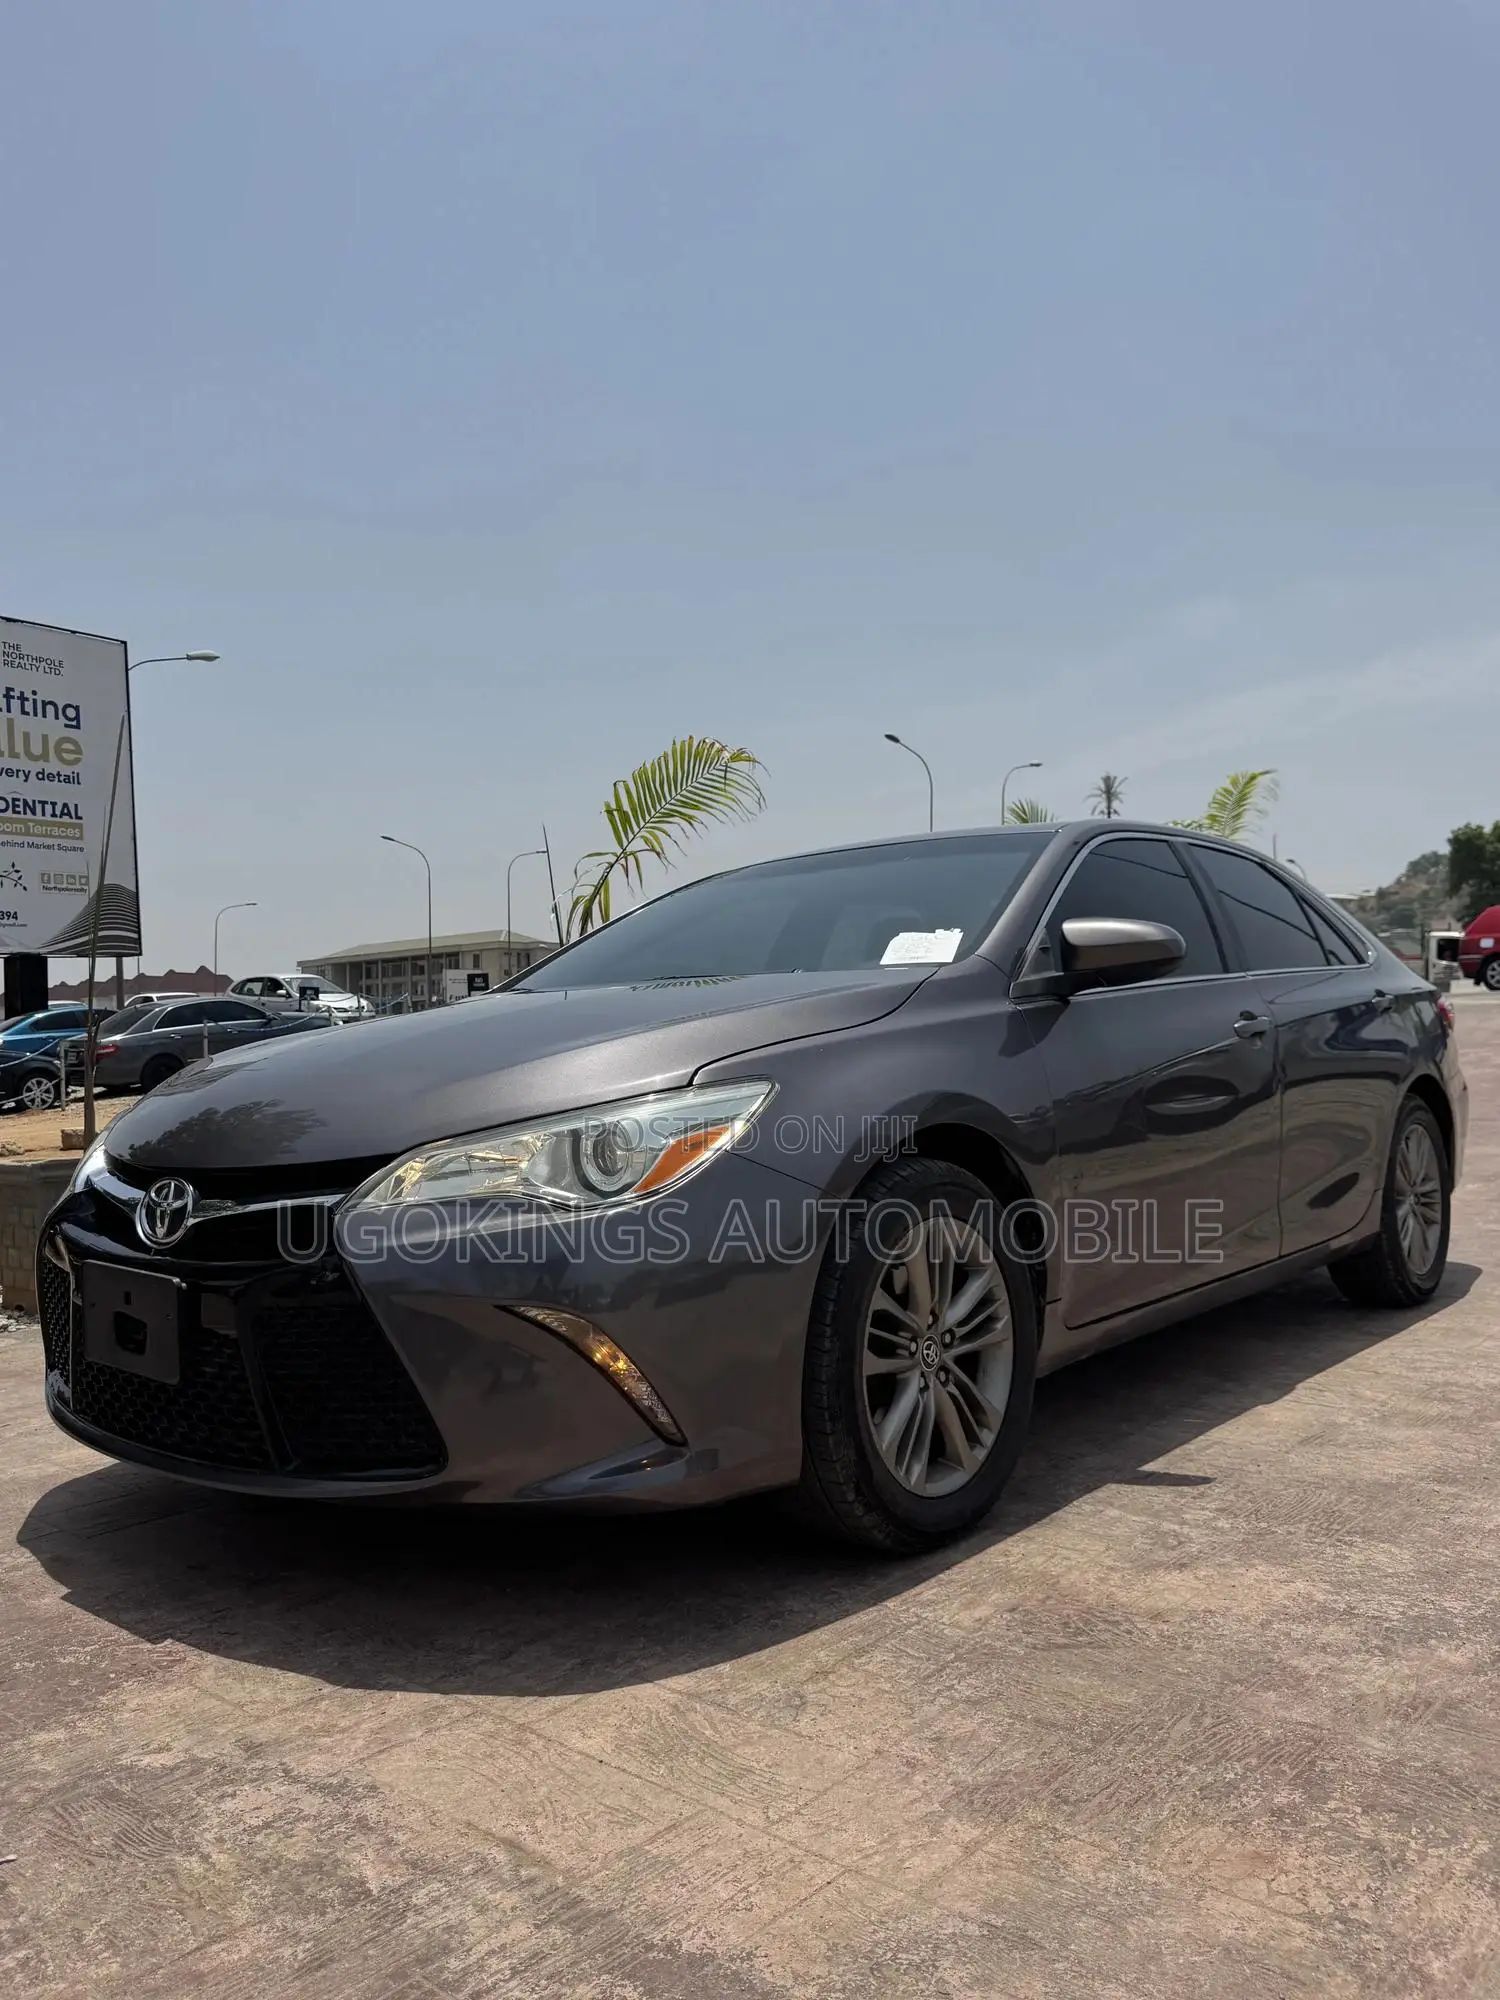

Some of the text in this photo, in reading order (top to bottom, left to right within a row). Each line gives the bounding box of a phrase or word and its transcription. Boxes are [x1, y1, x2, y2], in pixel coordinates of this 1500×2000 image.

[1, 641, 22, 652] THE
[2, 650, 65, 669] NORTHPOLE
[3, 659, 64, 677] REALTY LTD.
[0, 686, 81, 730] fting
[0, 717, 84, 766] lue
[35, 768, 82, 785] detail
[27, 822, 81, 837] Terraces
[26, 841, 55, 850] Market
[57, 843, 85, 853] Square
